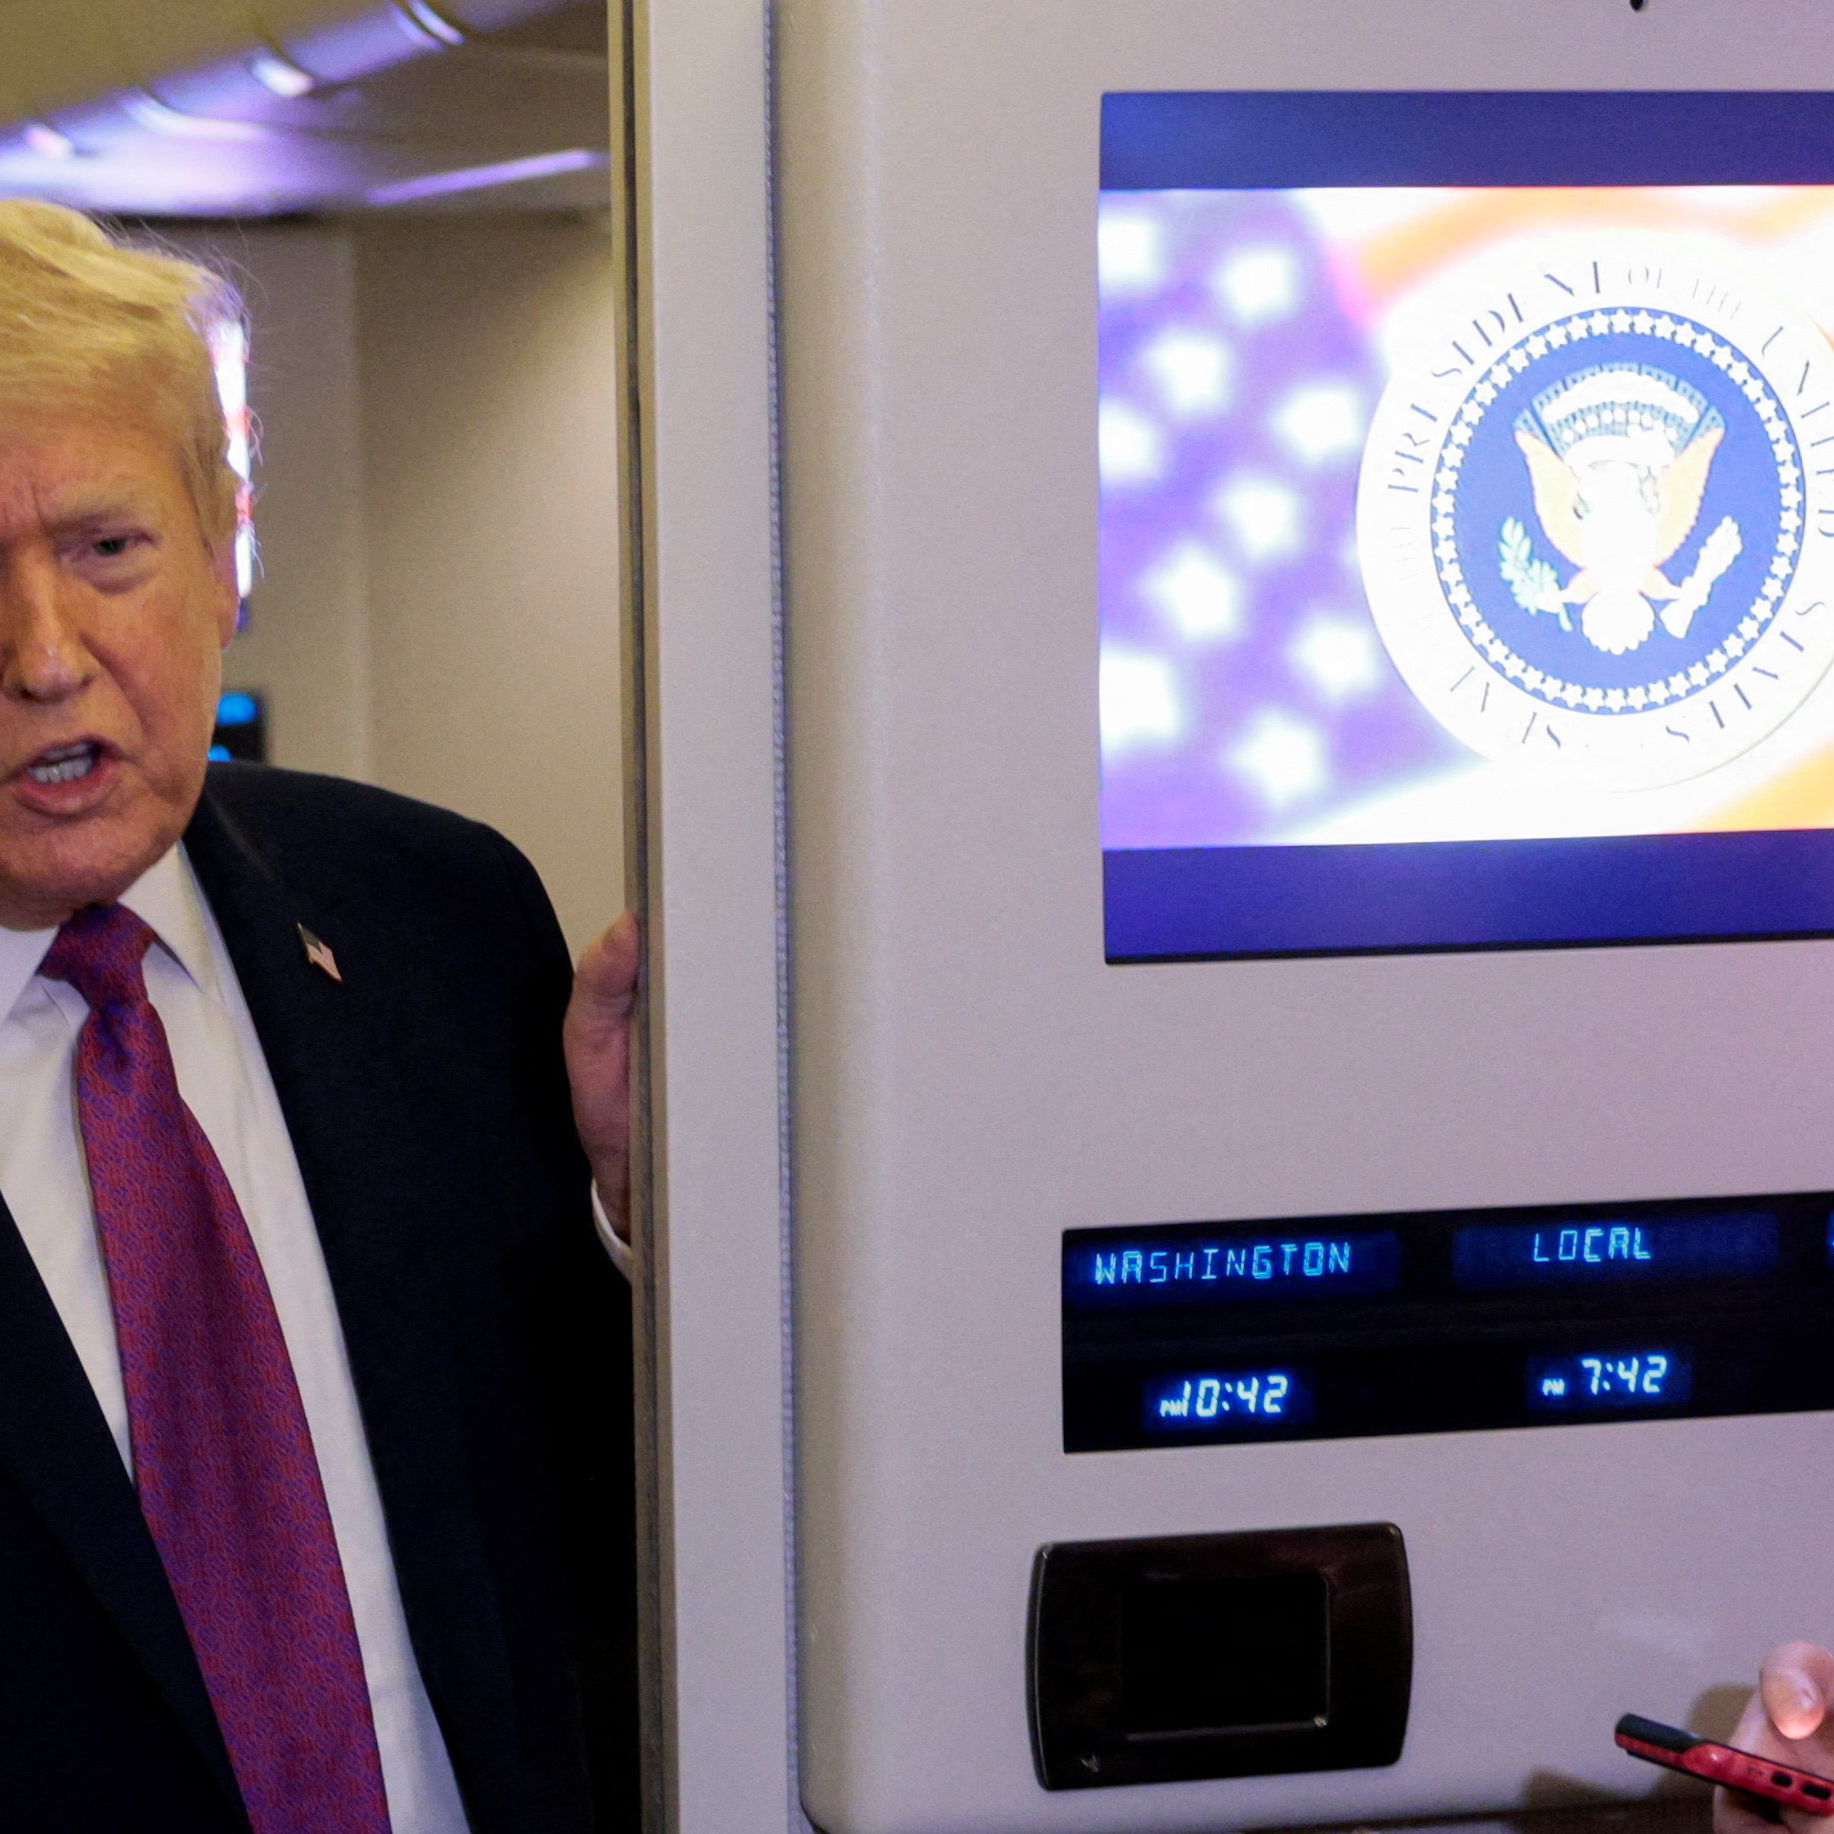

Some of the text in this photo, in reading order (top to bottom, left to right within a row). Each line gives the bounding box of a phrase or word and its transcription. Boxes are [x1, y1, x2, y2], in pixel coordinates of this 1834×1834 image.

[1094, 1241, 1351, 1285] WASHINGTON
[1532, 1226, 1652, 1263] LOCAL
[1180, 1374, 1289, 1417] 10:42
[1581, 1354, 1668, 1396] 7:42
